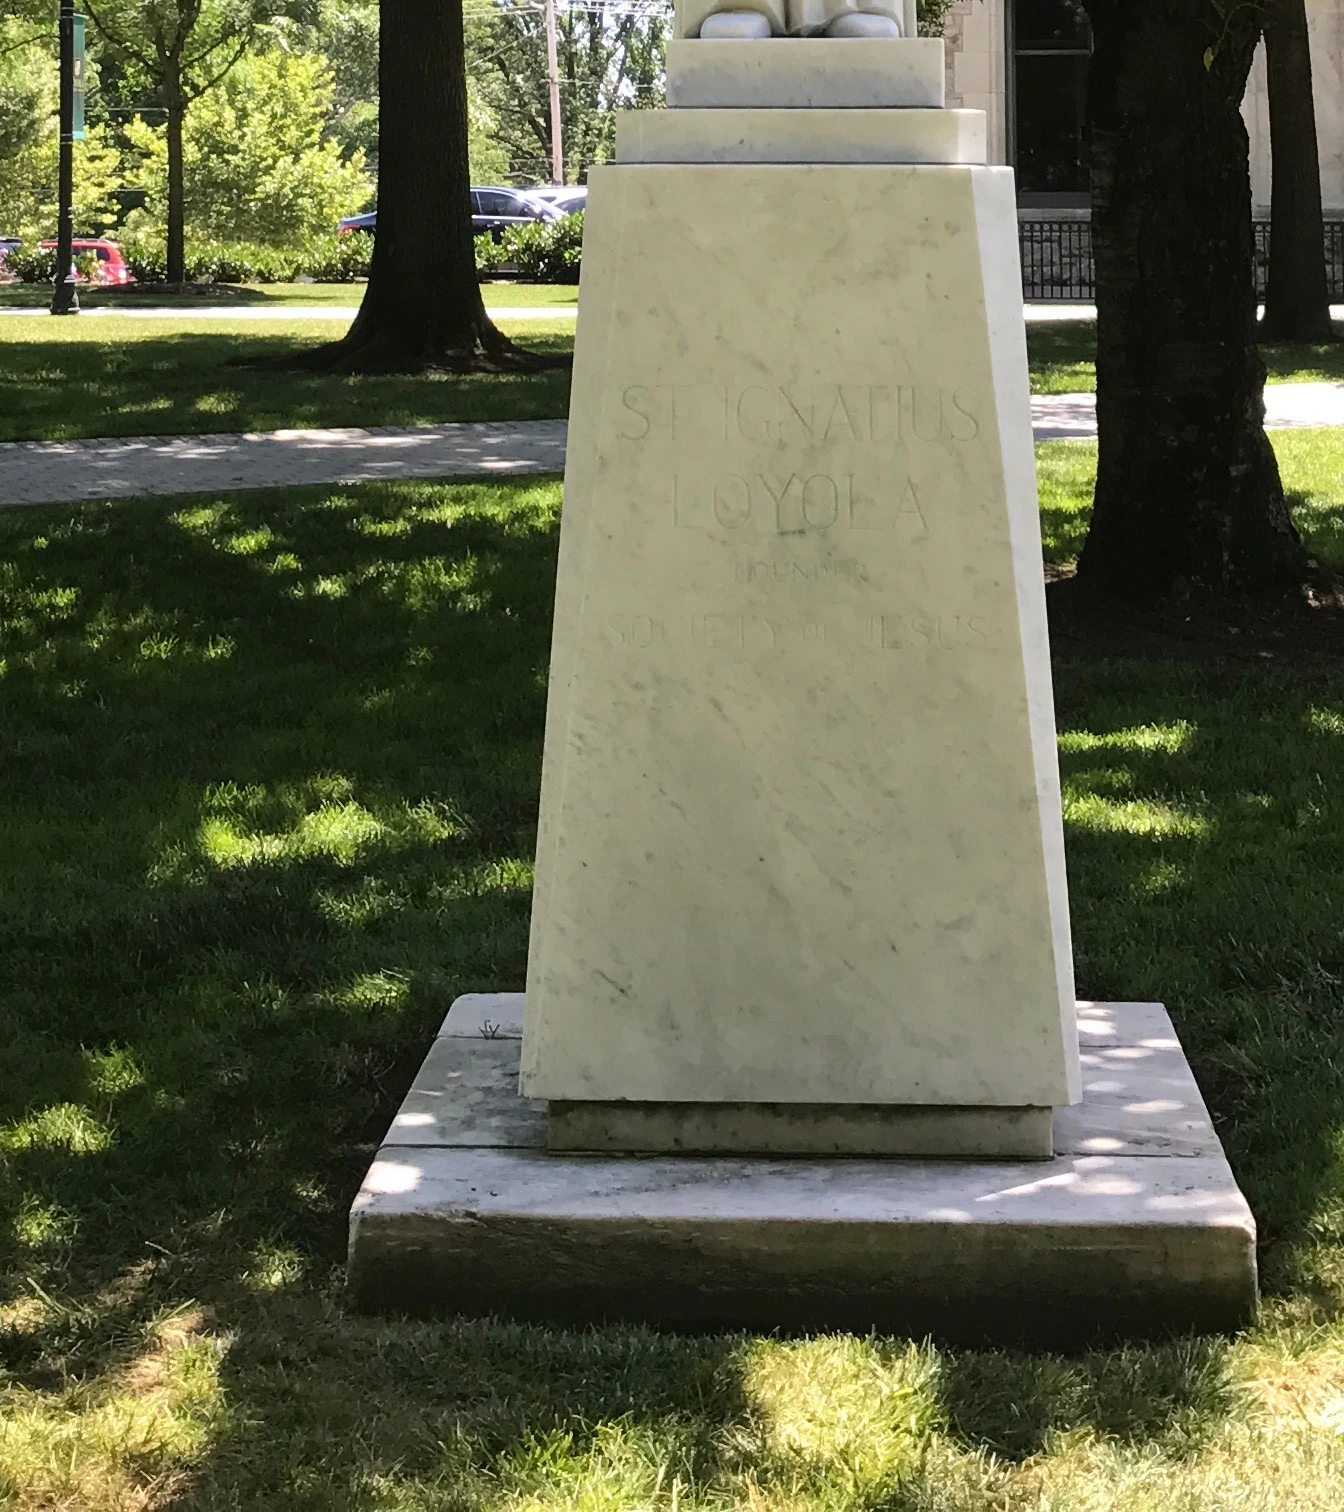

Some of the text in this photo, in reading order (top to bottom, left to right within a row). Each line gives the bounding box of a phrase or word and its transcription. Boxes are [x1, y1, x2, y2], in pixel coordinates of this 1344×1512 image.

[722, 383, 981, 443] IGNATIUS
[672, 471, 930, 531] LOYOLA
[606, 613, 784, 651] SOCIETY
[857, 613, 991, 652] JESUS
